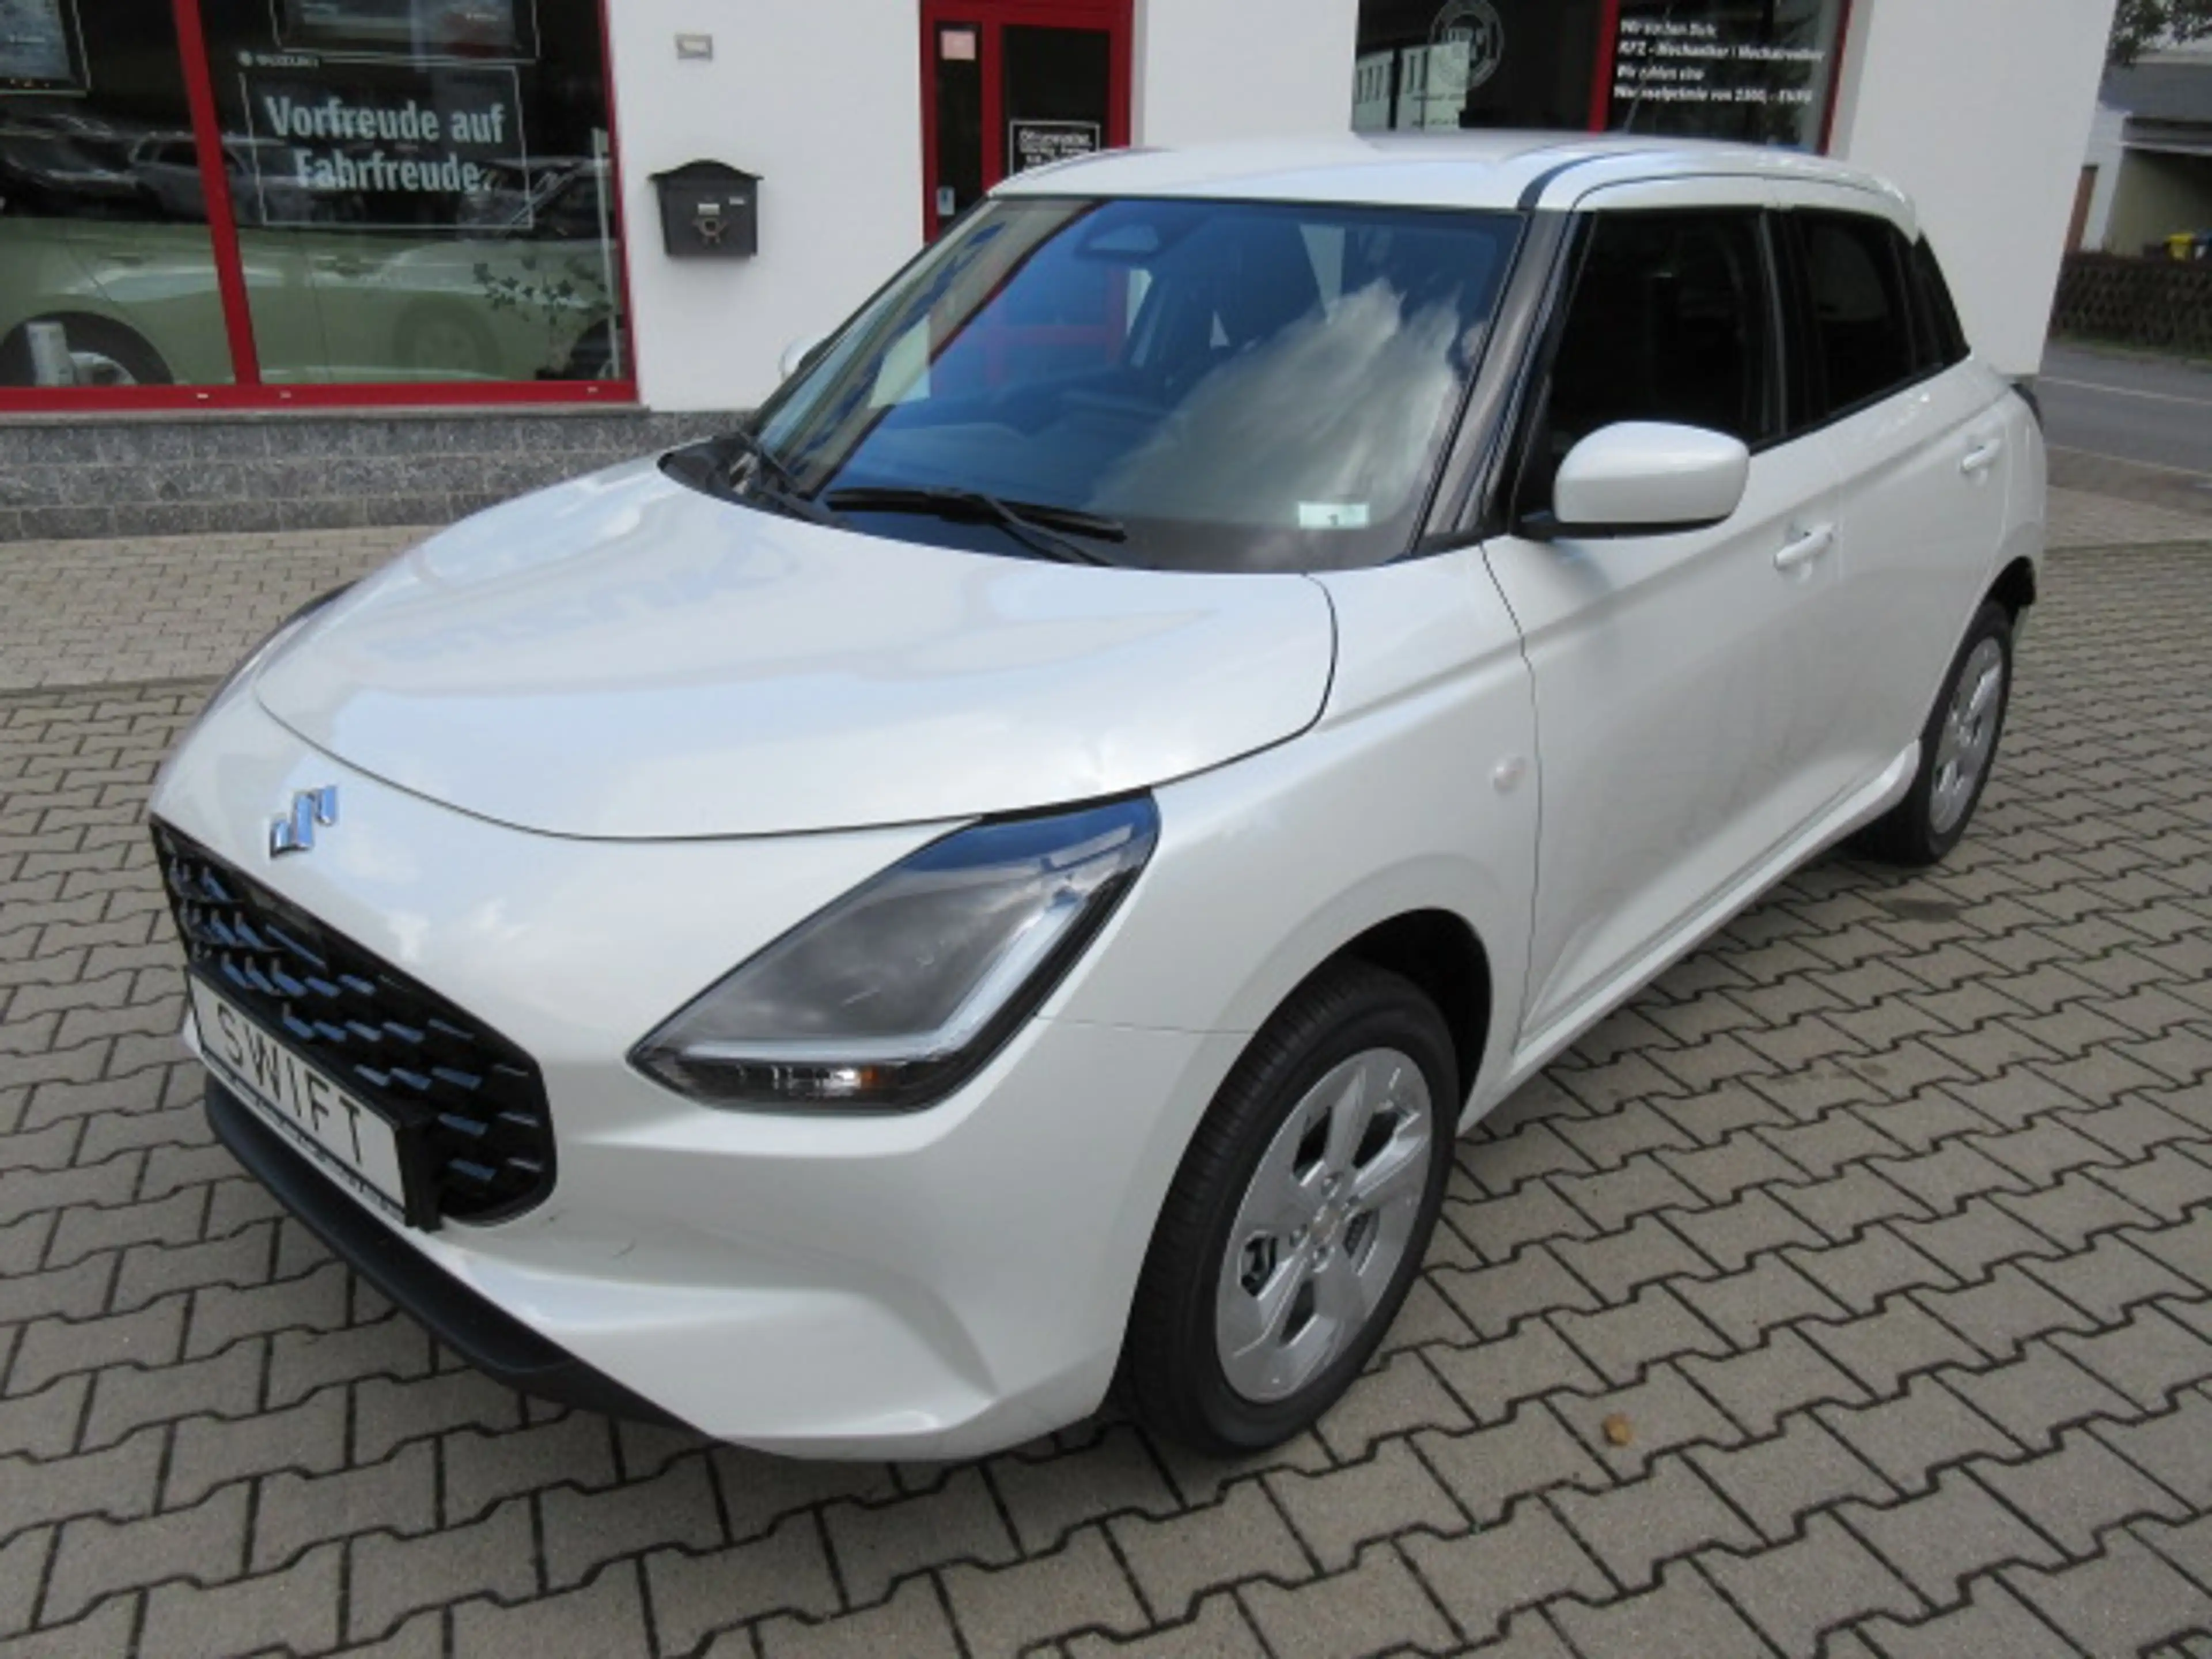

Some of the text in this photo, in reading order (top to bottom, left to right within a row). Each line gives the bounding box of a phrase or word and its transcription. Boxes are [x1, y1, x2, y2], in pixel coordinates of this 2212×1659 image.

[264, 95, 506, 143] Vorfreude auf
[292, 147, 492, 193] Fahrfreude.
[216, 1002, 361, 1165] SWIFT
